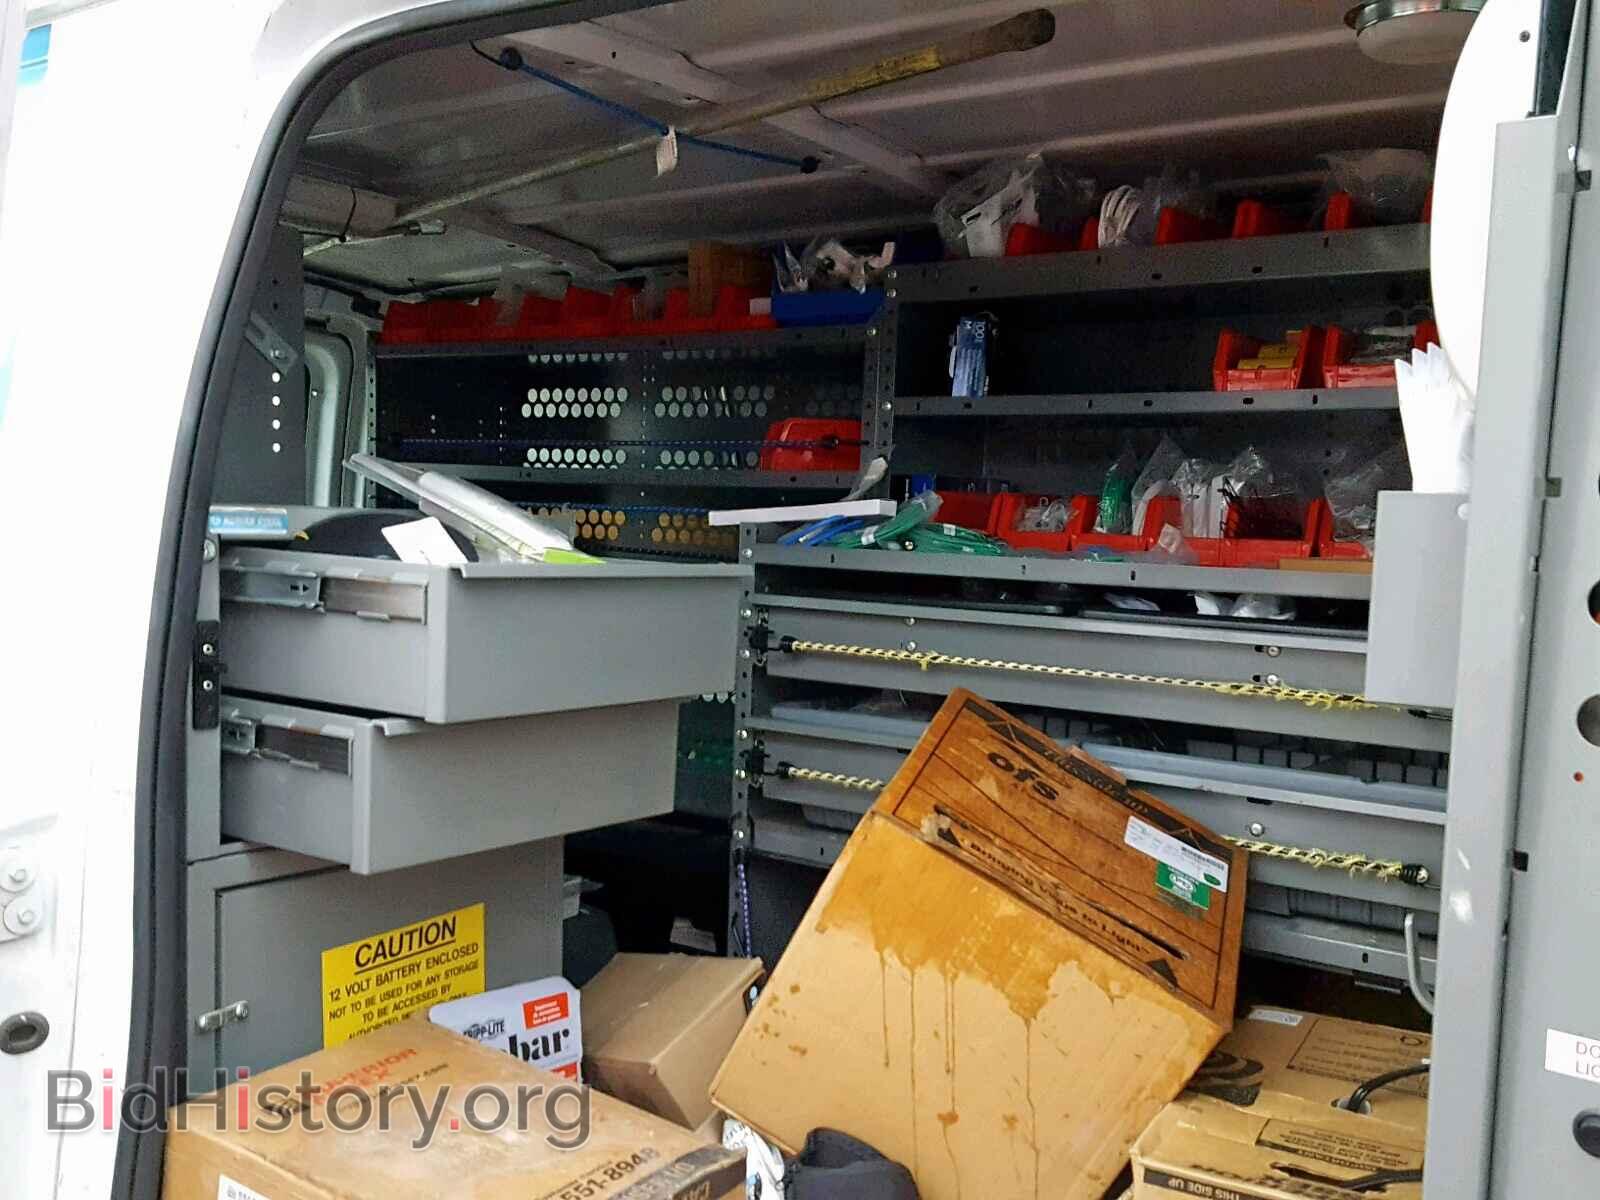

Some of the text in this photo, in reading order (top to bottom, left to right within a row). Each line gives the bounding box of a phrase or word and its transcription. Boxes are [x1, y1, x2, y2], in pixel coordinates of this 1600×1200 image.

[354, 915, 457, 968] CAUTION
[328, 959, 479, 1022] NOT TO BE USED FOR ANY STORAGE
[329, 942, 479, 1003] 12 VOLT BATTERY ENCLOSED
[362, 1010, 374, 1025] TO
[377, 1005, 388, 1019] BE
[392, 988, 438, 1012] ACCESSED
[440, 983, 453, 995] BY
[505, 1028, 570, 1062] bar
